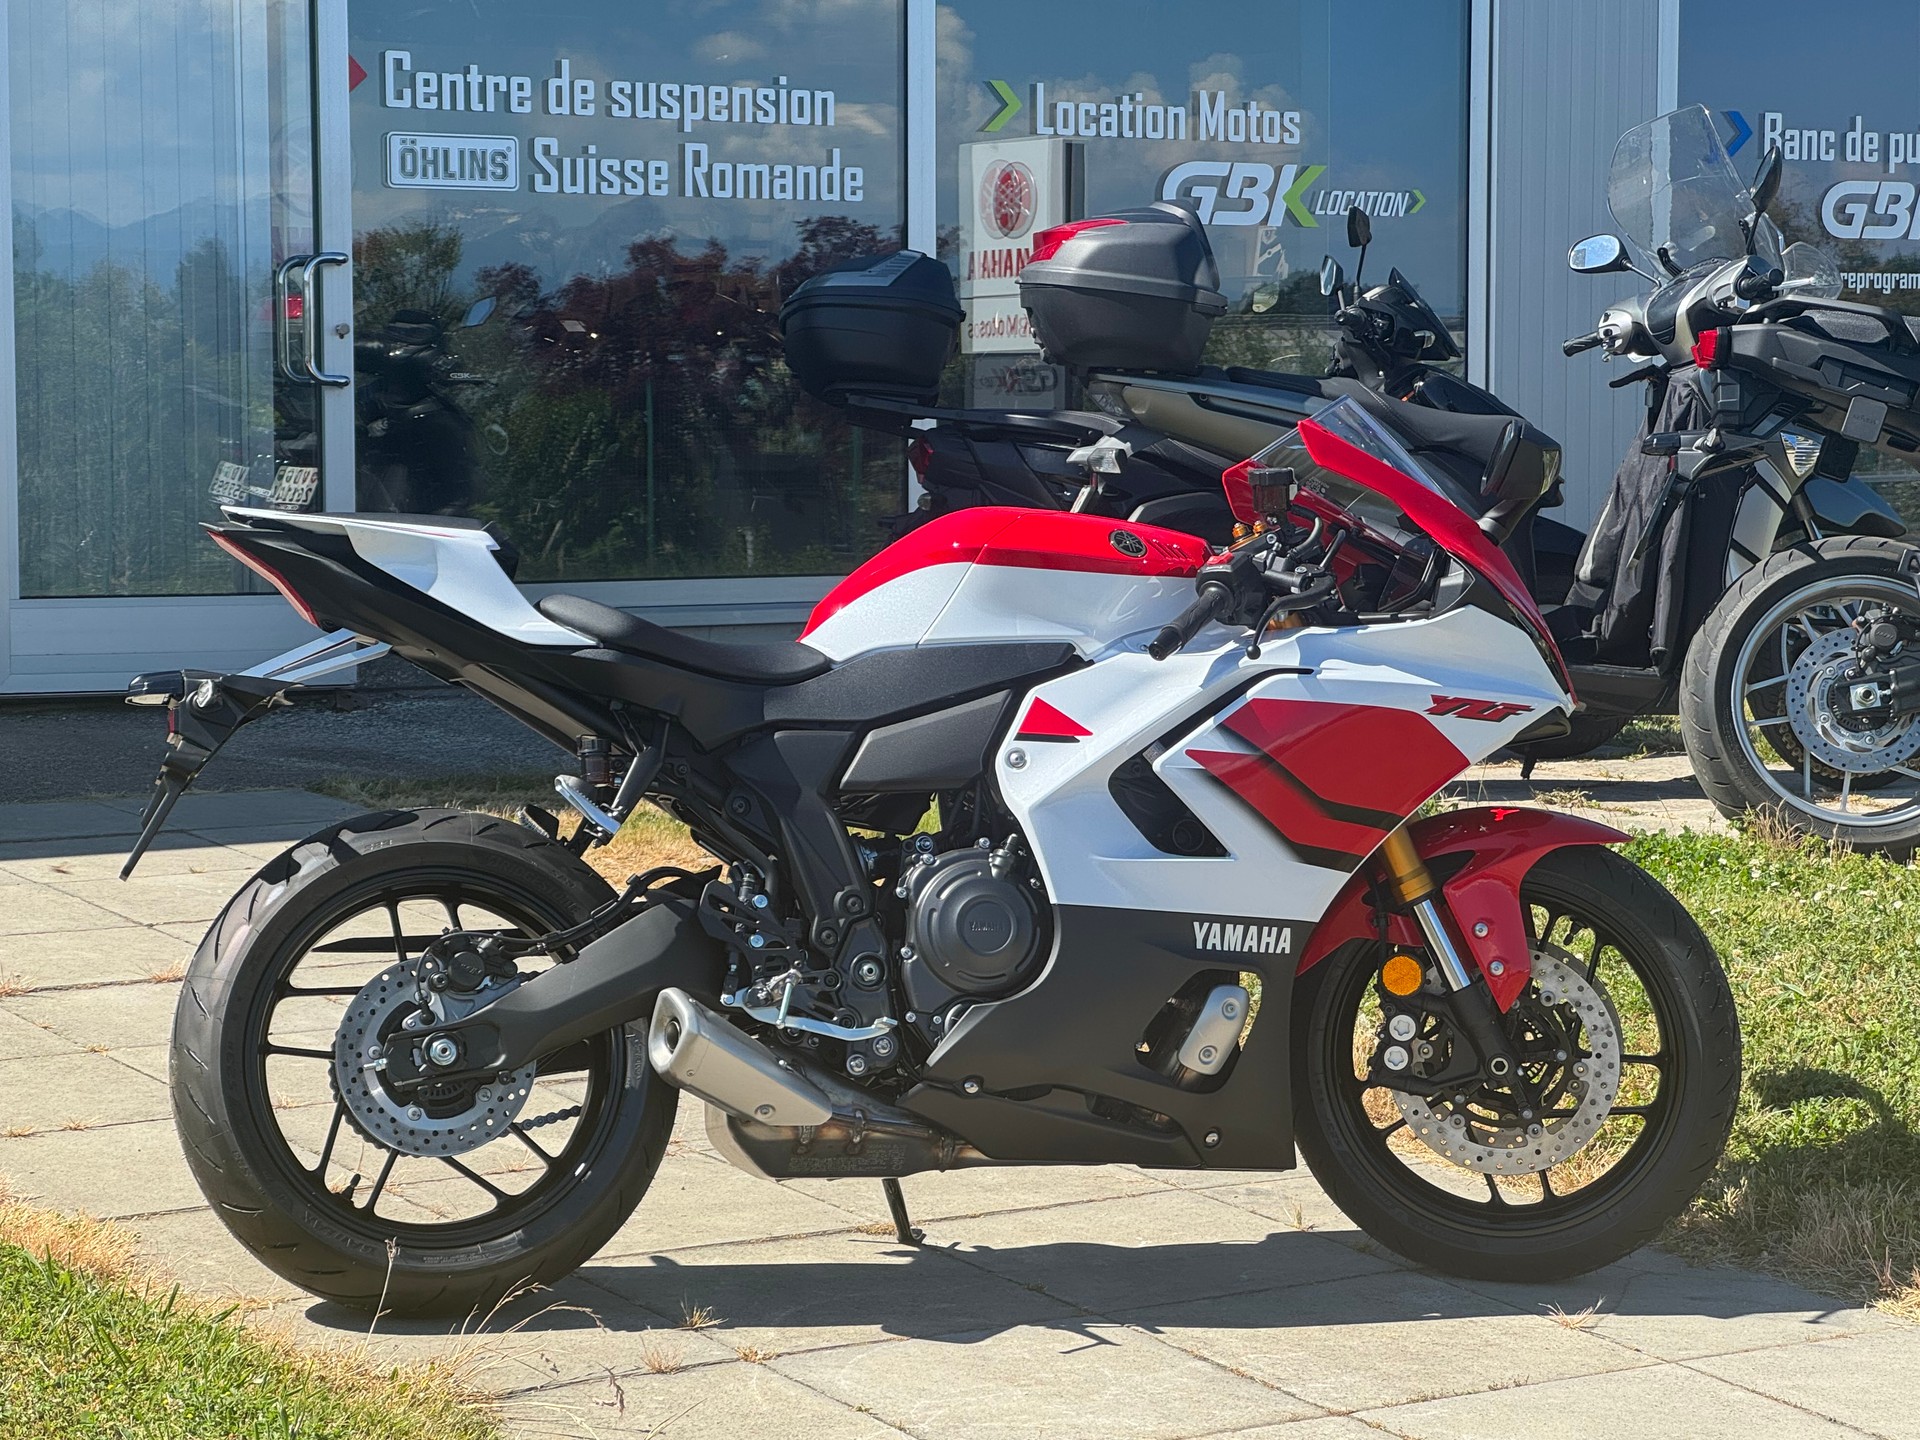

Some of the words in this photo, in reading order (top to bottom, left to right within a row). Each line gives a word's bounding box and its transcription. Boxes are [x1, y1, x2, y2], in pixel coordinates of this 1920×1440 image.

[384, 50, 531, 114] Centre
[548, 59, 595, 116] de
[611, 76, 835, 132] suspension
[1036, 82, 1186, 139] Location
[1200, 90, 1300, 144] Motos
[398, 138, 509, 182] ÖHLINS
[1763, 112, 1835, 161] Banc
[1845, 115, 1879, 162] de
[534, 137, 669, 196] Suisse
[684, 142, 864, 202] Romande
[1162, 161, 1327, 228] GBK
[1314, 190, 1410, 217] LOCATION
[1821, 180, 1920, 240] GB
[1193, 921, 1291, 954] YAMAHA
